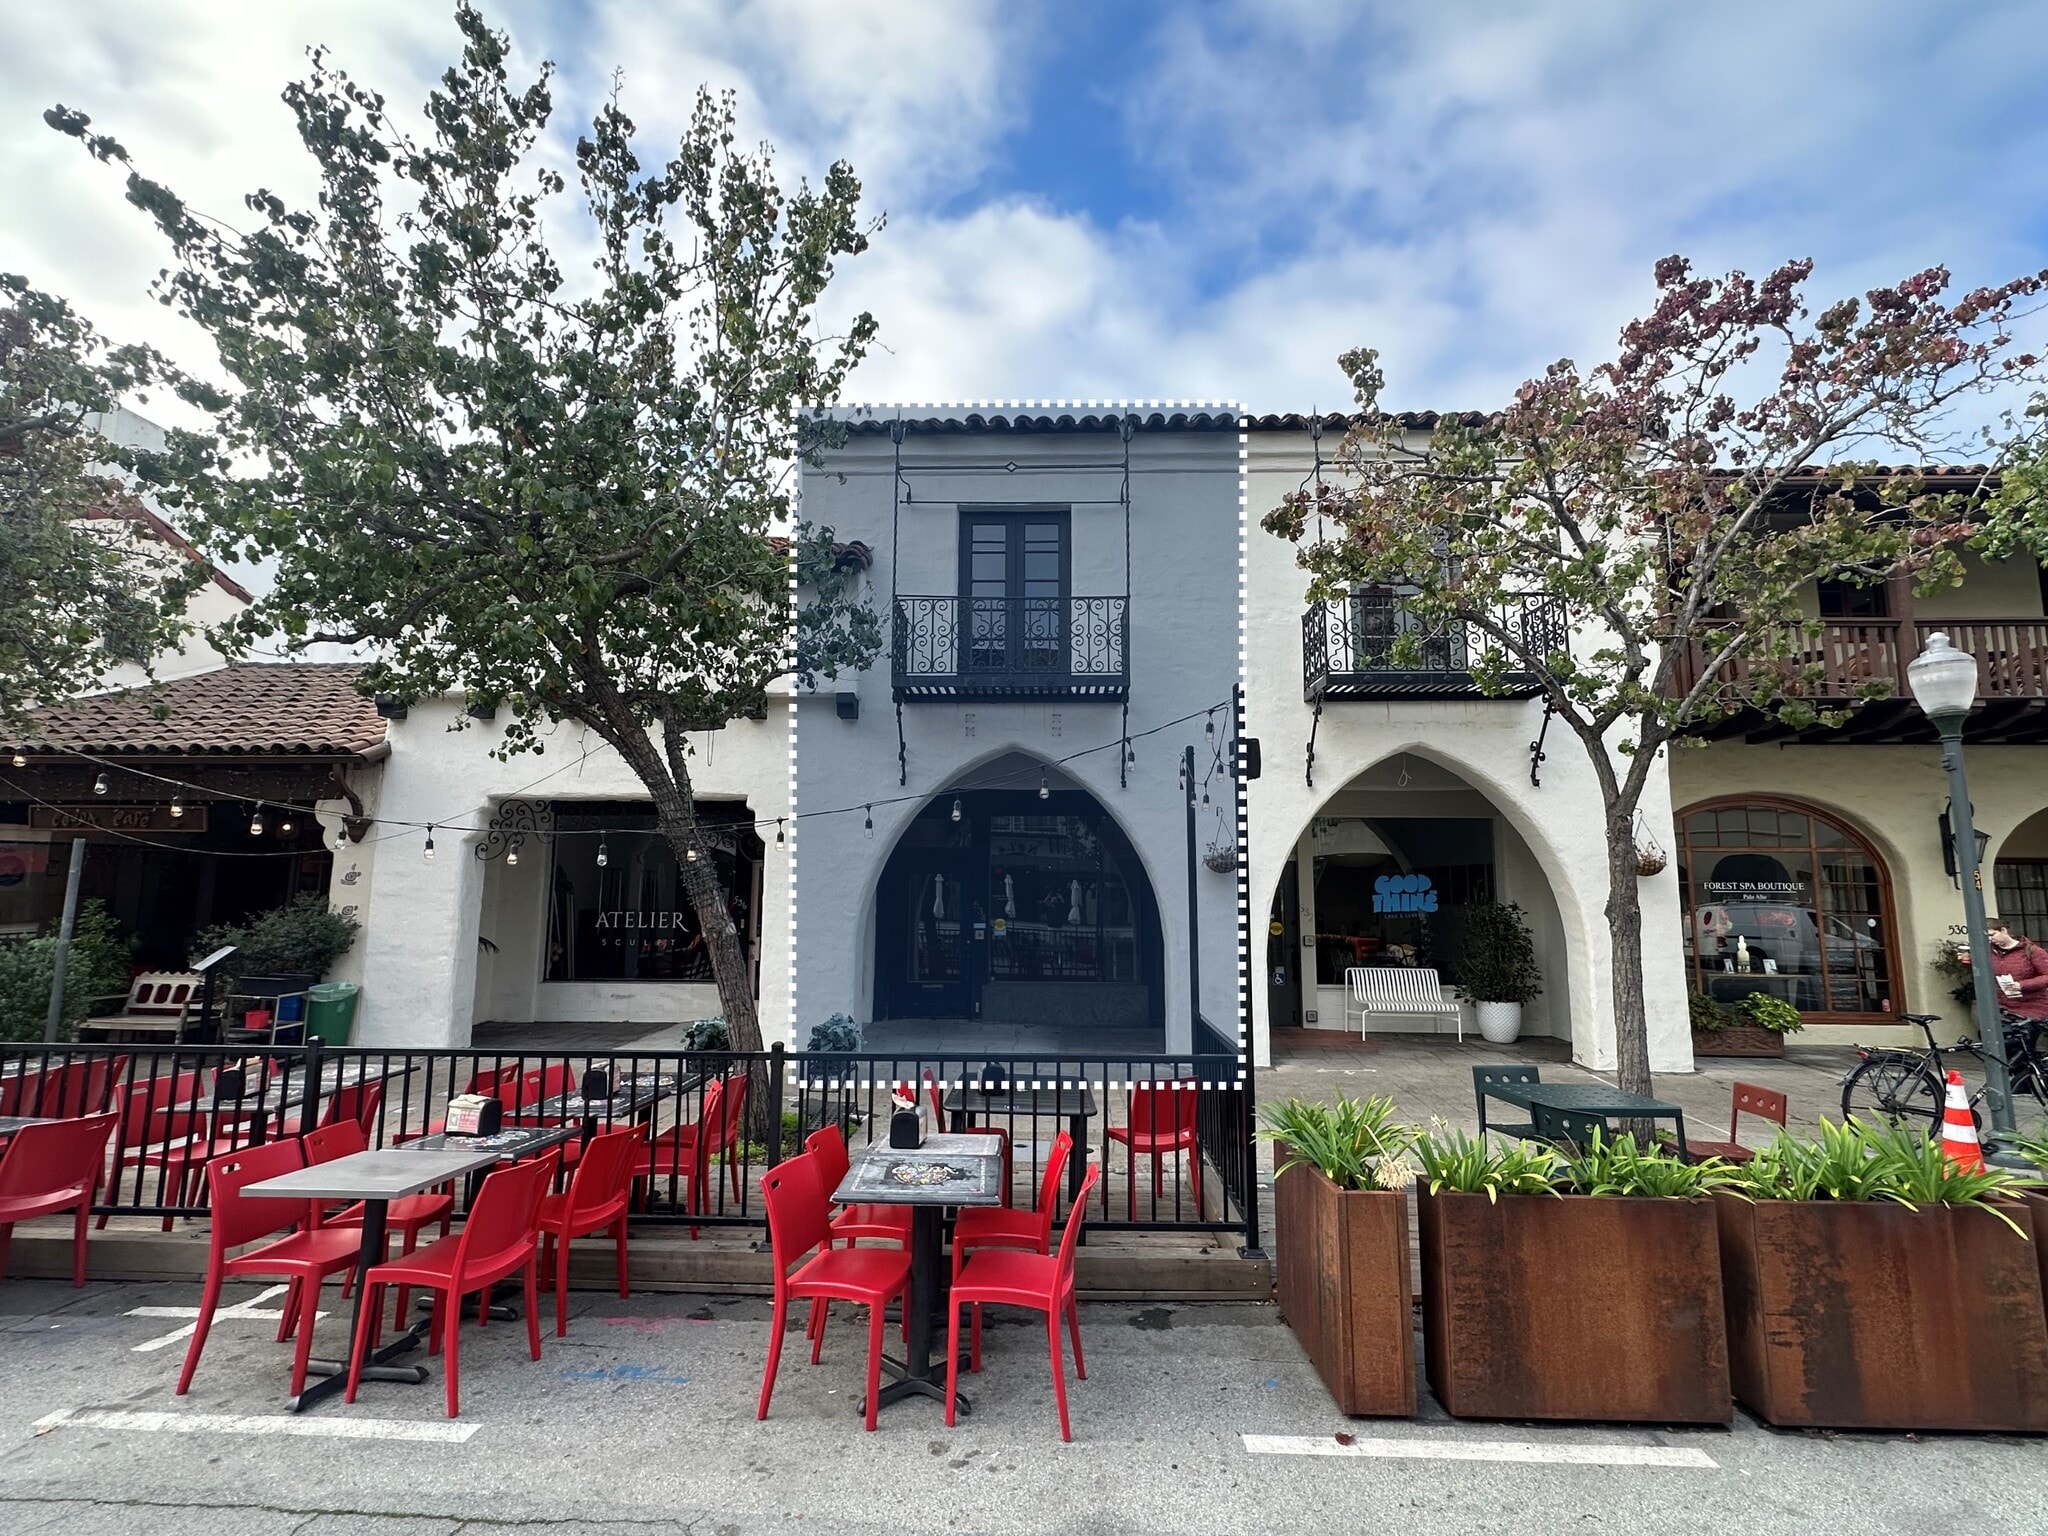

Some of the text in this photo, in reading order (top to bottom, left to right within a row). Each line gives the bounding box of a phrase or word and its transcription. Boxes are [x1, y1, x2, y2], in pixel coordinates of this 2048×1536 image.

[1374, 874, 1432, 893] GOOD
[1703, 881, 1805, 892] FOREST SPA BOUTIQUE
[1372, 889, 1439, 913] THING
[595, 910, 690, 933] ATELIER
[1948, 925, 1969, 936] 530
[601, 938, 676, 947] SCULPT
